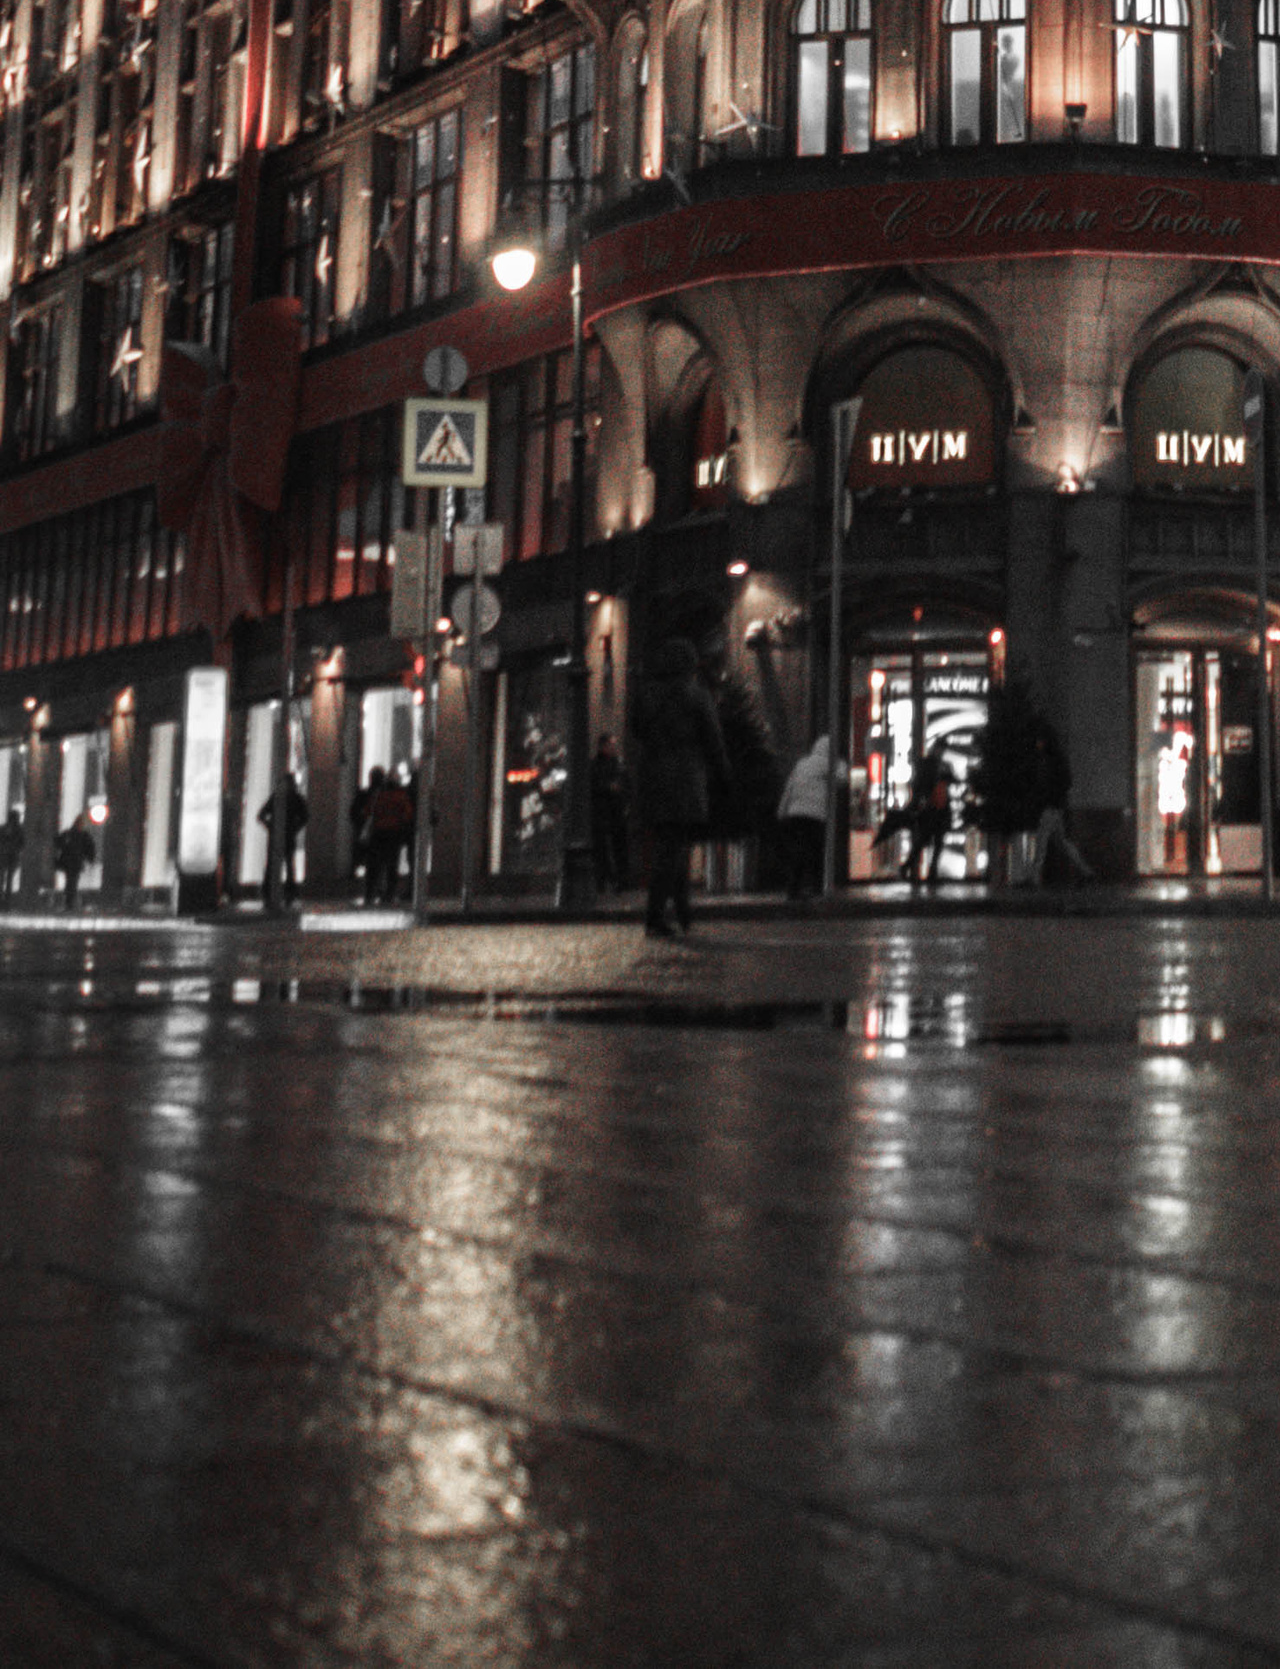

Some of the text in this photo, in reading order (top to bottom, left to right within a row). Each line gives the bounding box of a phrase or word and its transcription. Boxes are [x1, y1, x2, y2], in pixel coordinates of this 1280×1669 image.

[925, 182, 1097, 237] Новым
[1110, 184, 1242, 236] Годом
[688, 212, 751, 277] Year
